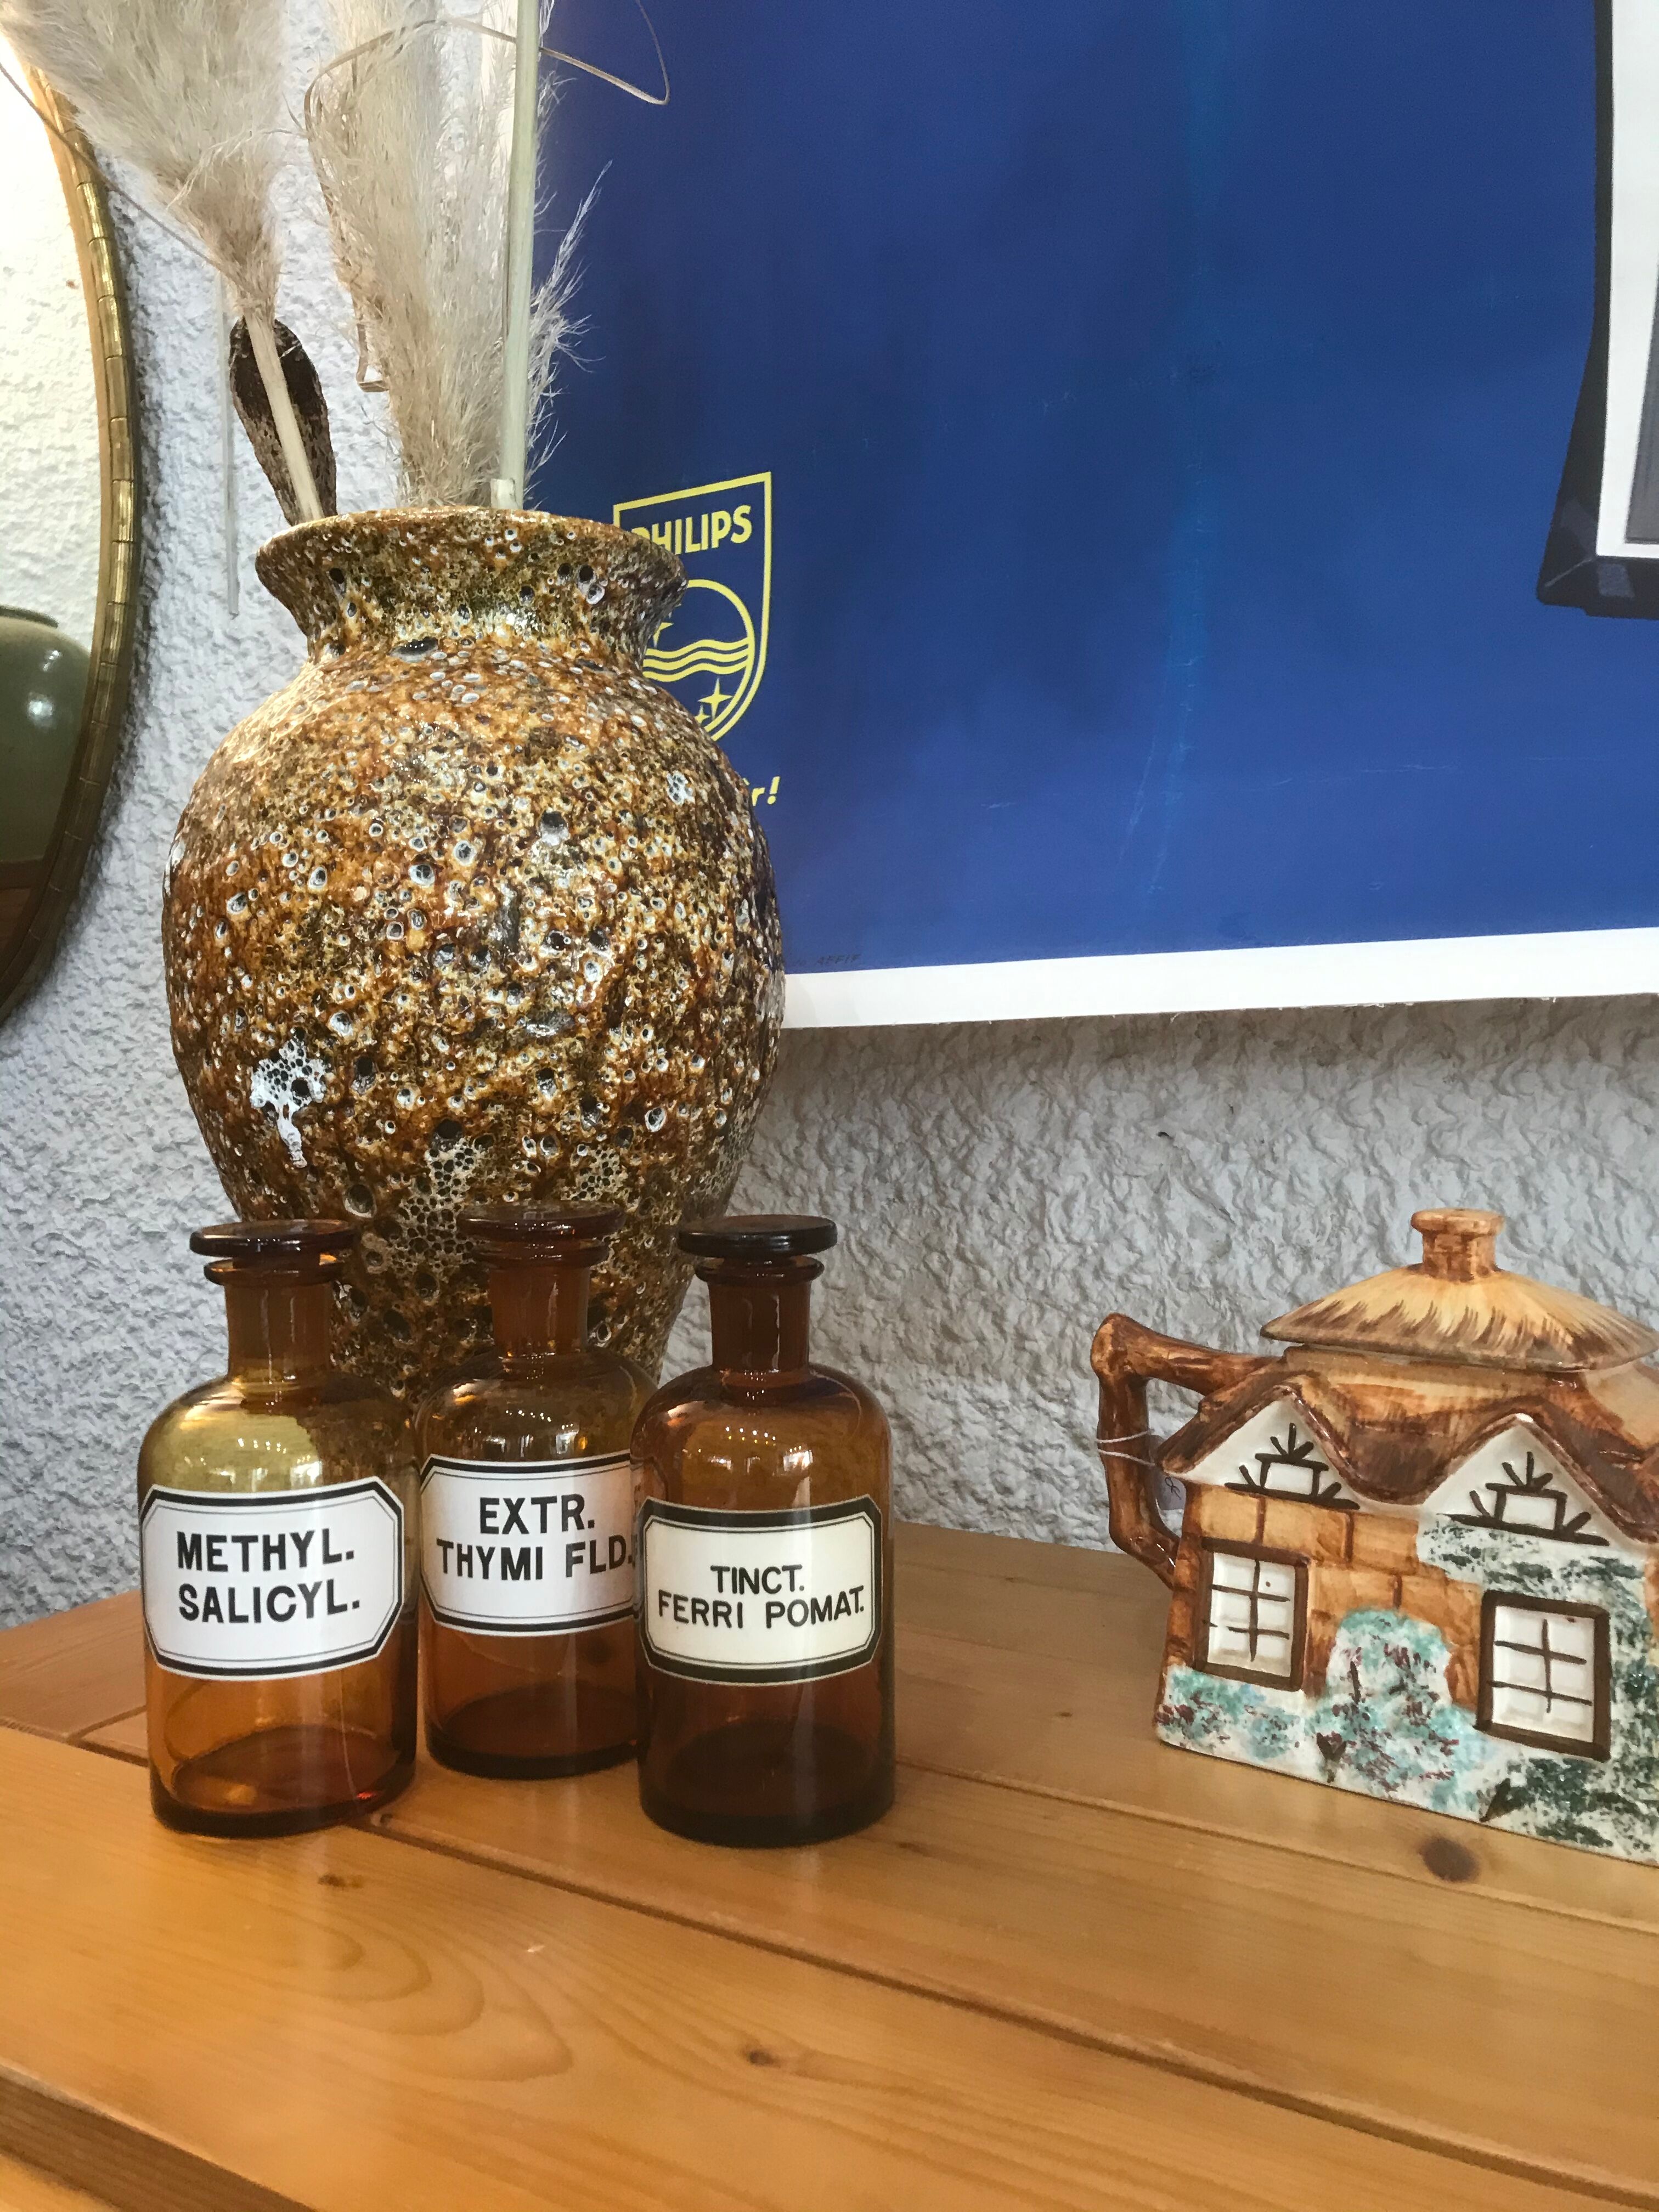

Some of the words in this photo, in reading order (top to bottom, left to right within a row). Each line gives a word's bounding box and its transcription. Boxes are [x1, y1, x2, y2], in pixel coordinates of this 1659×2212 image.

[479, 1493, 595, 1534] EXTR.
[177, 1527, 355, 1572] METHYL.
[436, 1537, 543, 1581] THYMI
[565, 1534, 634, 1578] FLD.
[178, 1579, 360, 1624] SALICYL.
[710, 1564, 805, 1595] TINCT.
[658, 1589, 744, 1629] FERRI
[765, 1584, 865, 1629] POMAT.
